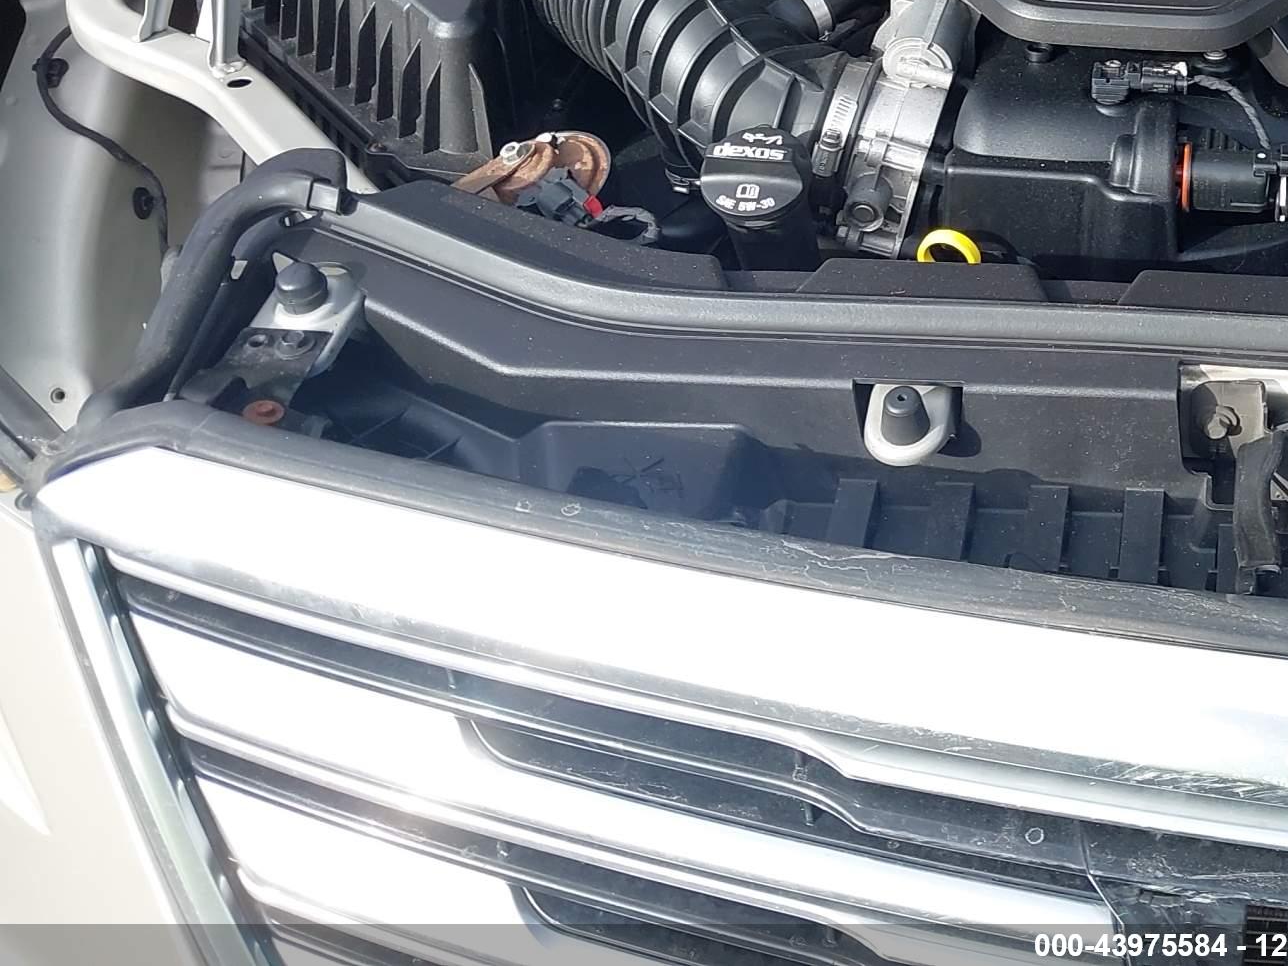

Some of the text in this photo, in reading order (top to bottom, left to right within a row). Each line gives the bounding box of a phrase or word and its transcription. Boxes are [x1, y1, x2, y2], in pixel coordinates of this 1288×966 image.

[713, 142, 785, 161] dexos
[715, 194, 776, 212] SAE 5W-30
